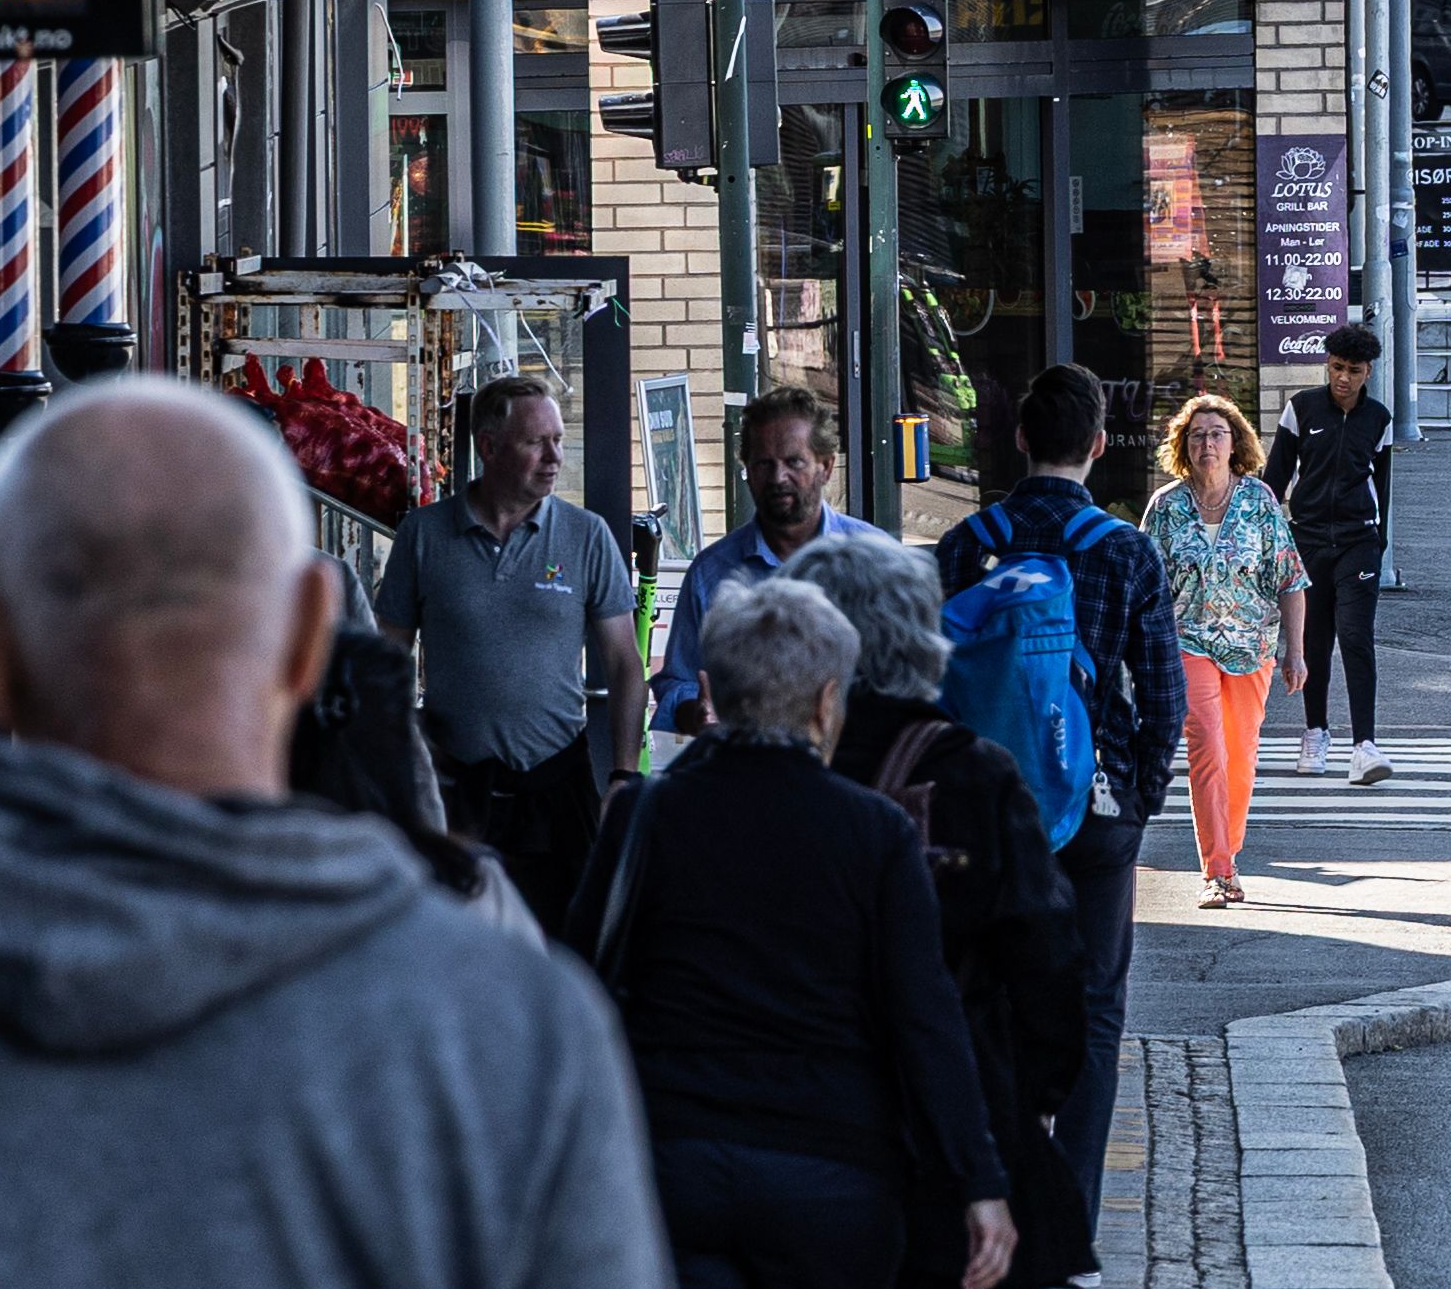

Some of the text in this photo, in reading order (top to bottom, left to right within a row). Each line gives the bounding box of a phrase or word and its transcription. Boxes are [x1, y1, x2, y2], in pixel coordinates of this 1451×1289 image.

[1271, 181, 1333, 198] LOTUS
[1276, 201, 1328, 212] GRILL BAR
[1265, 221, 1340, 232] ÅPNINGSTIDER
[1280, 238, 1301, 247] Man
[1265, 252, 1342, 266] 11.00-22.00
[1265, 287, 1342, 301] 12.30-22.00
[1270, 314, 1337, 325] VELKOMMEN!
